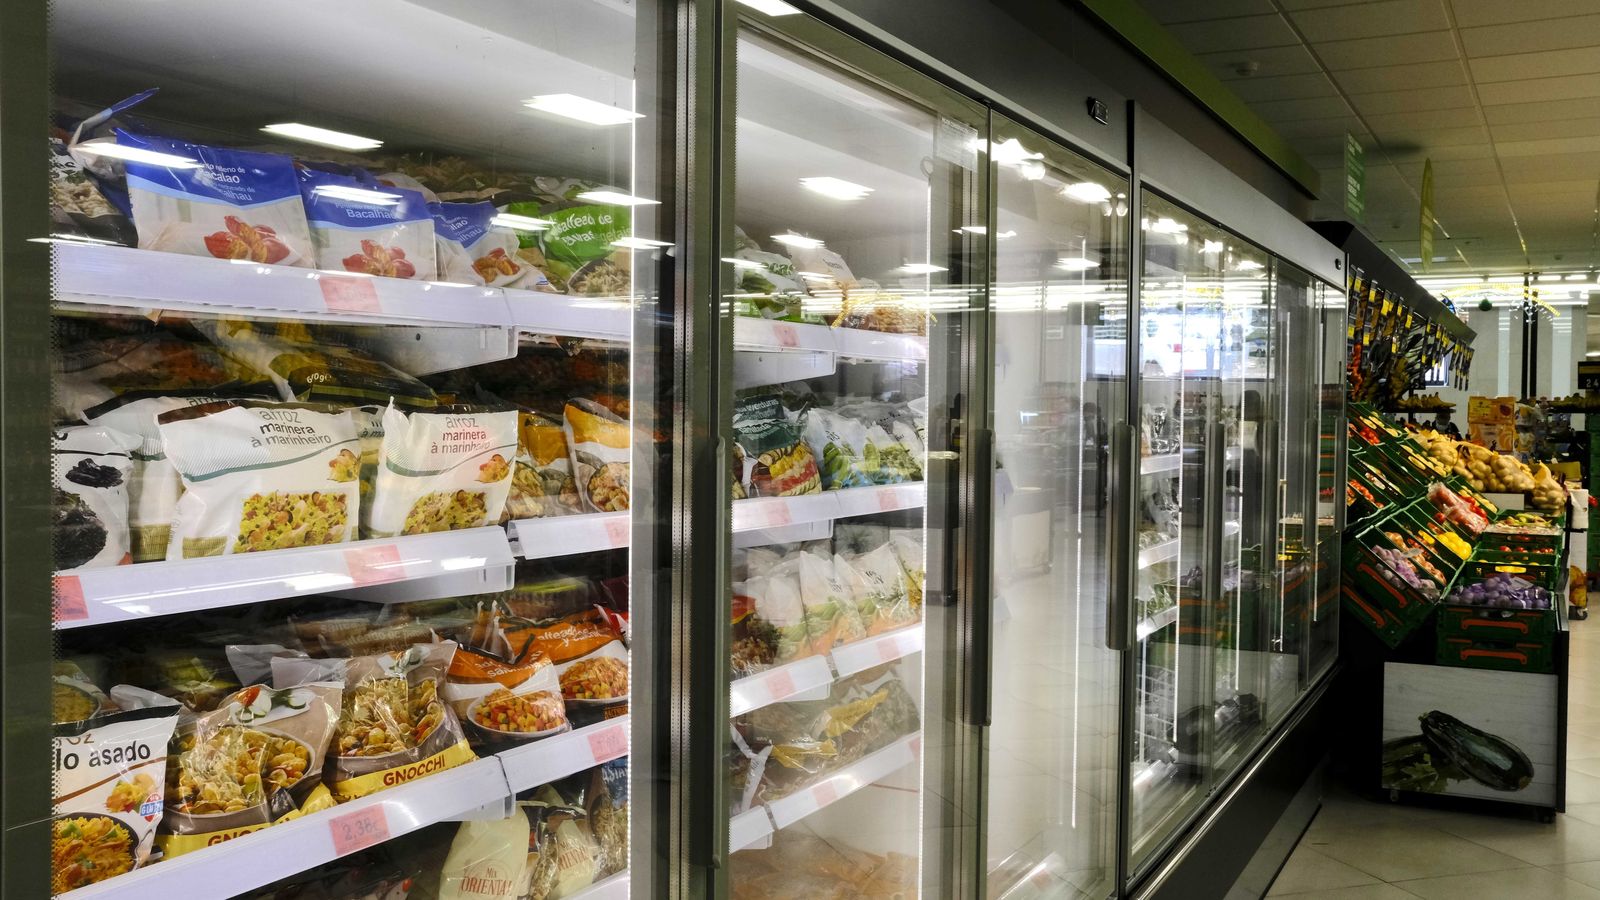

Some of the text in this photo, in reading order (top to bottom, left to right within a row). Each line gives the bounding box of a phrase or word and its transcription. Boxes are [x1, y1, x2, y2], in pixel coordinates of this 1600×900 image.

[259, 409, 302, 424] arroz
[445, 416, 480, 429] arroz
[260, 423, 316, 435] marinera
[442, 429, 487, 441] marinera
[251, 434, 332, 448] à marinheiro
[431, 442, 438, 454] à
[88, 740, 151, 768] asado
[382, 754, 446, 787] GNOCCHI
